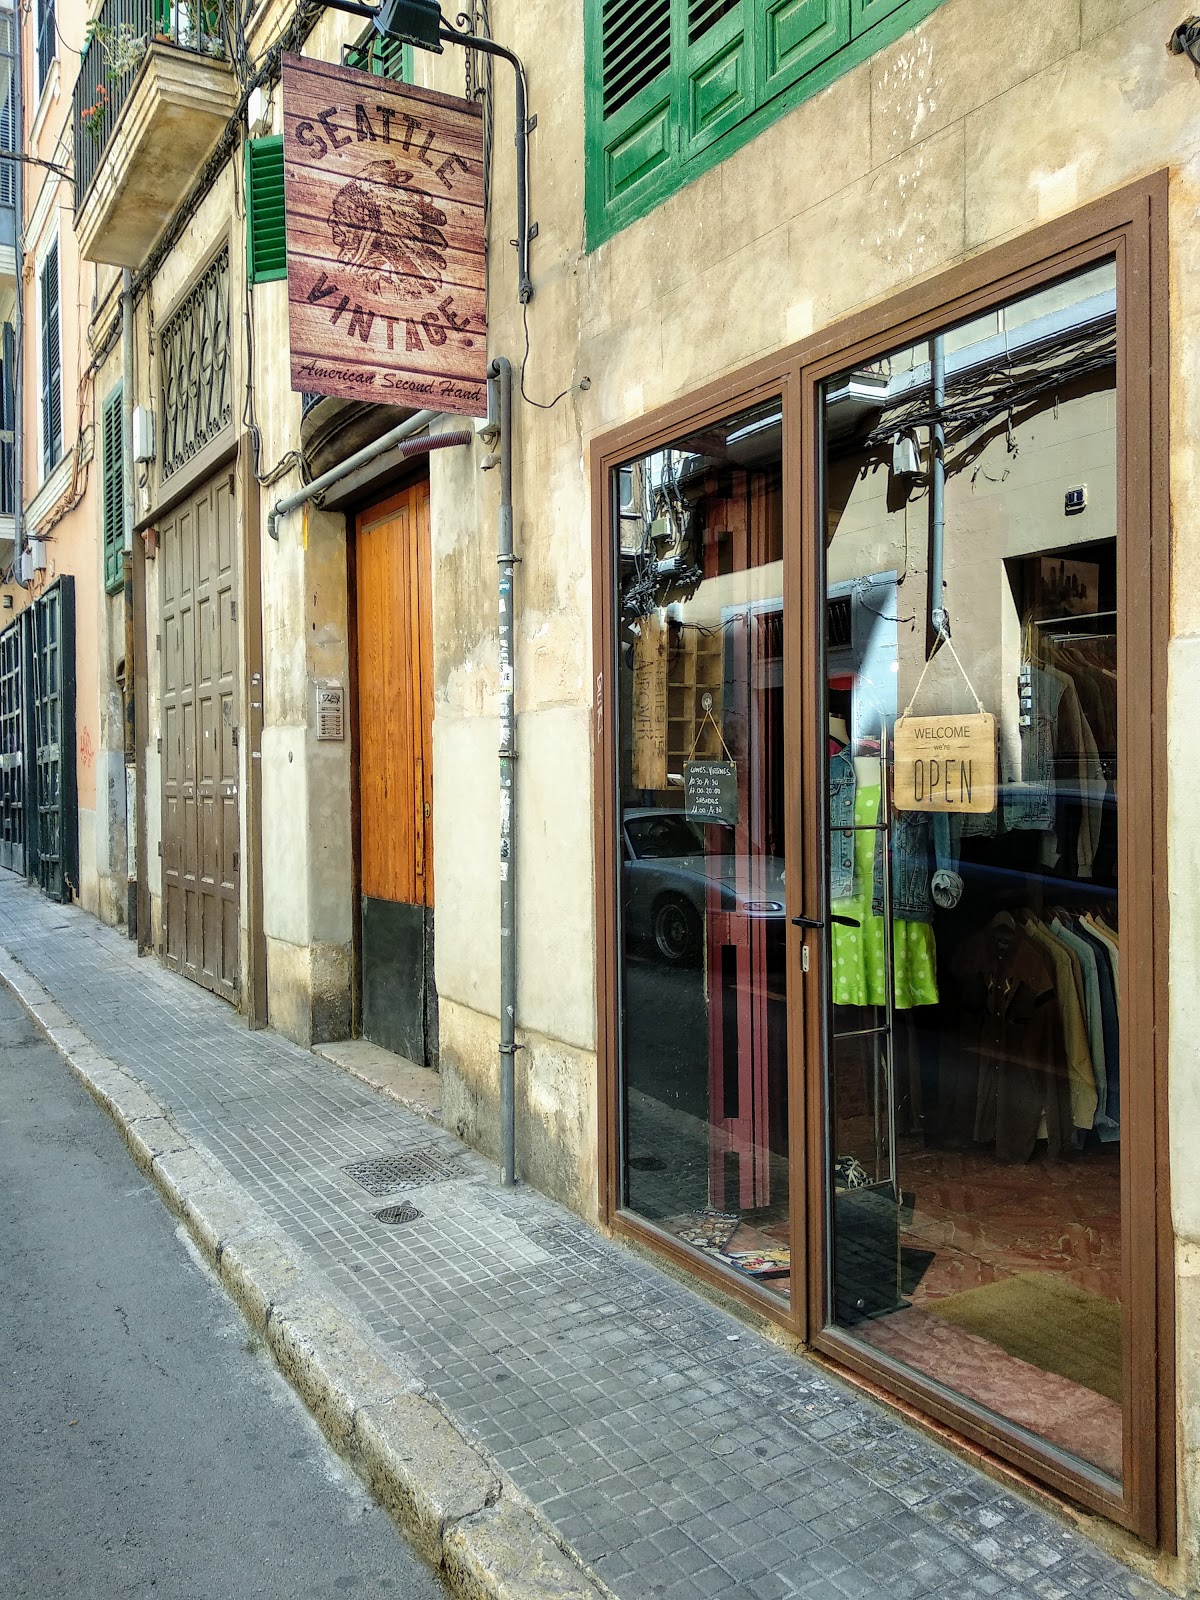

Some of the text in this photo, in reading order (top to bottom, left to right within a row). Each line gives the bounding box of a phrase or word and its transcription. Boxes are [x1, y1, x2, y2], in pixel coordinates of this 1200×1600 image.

[295, 103, 470, 190] SEATTLE
[306, 271, 470, 352] VINTAGE
[297, 360, 482, 401] American Second Hand
[914, 725, 970, 739] WELCOME
[933, 743, 950, 751] we're
[914, 759, 972, 804] OPEN
